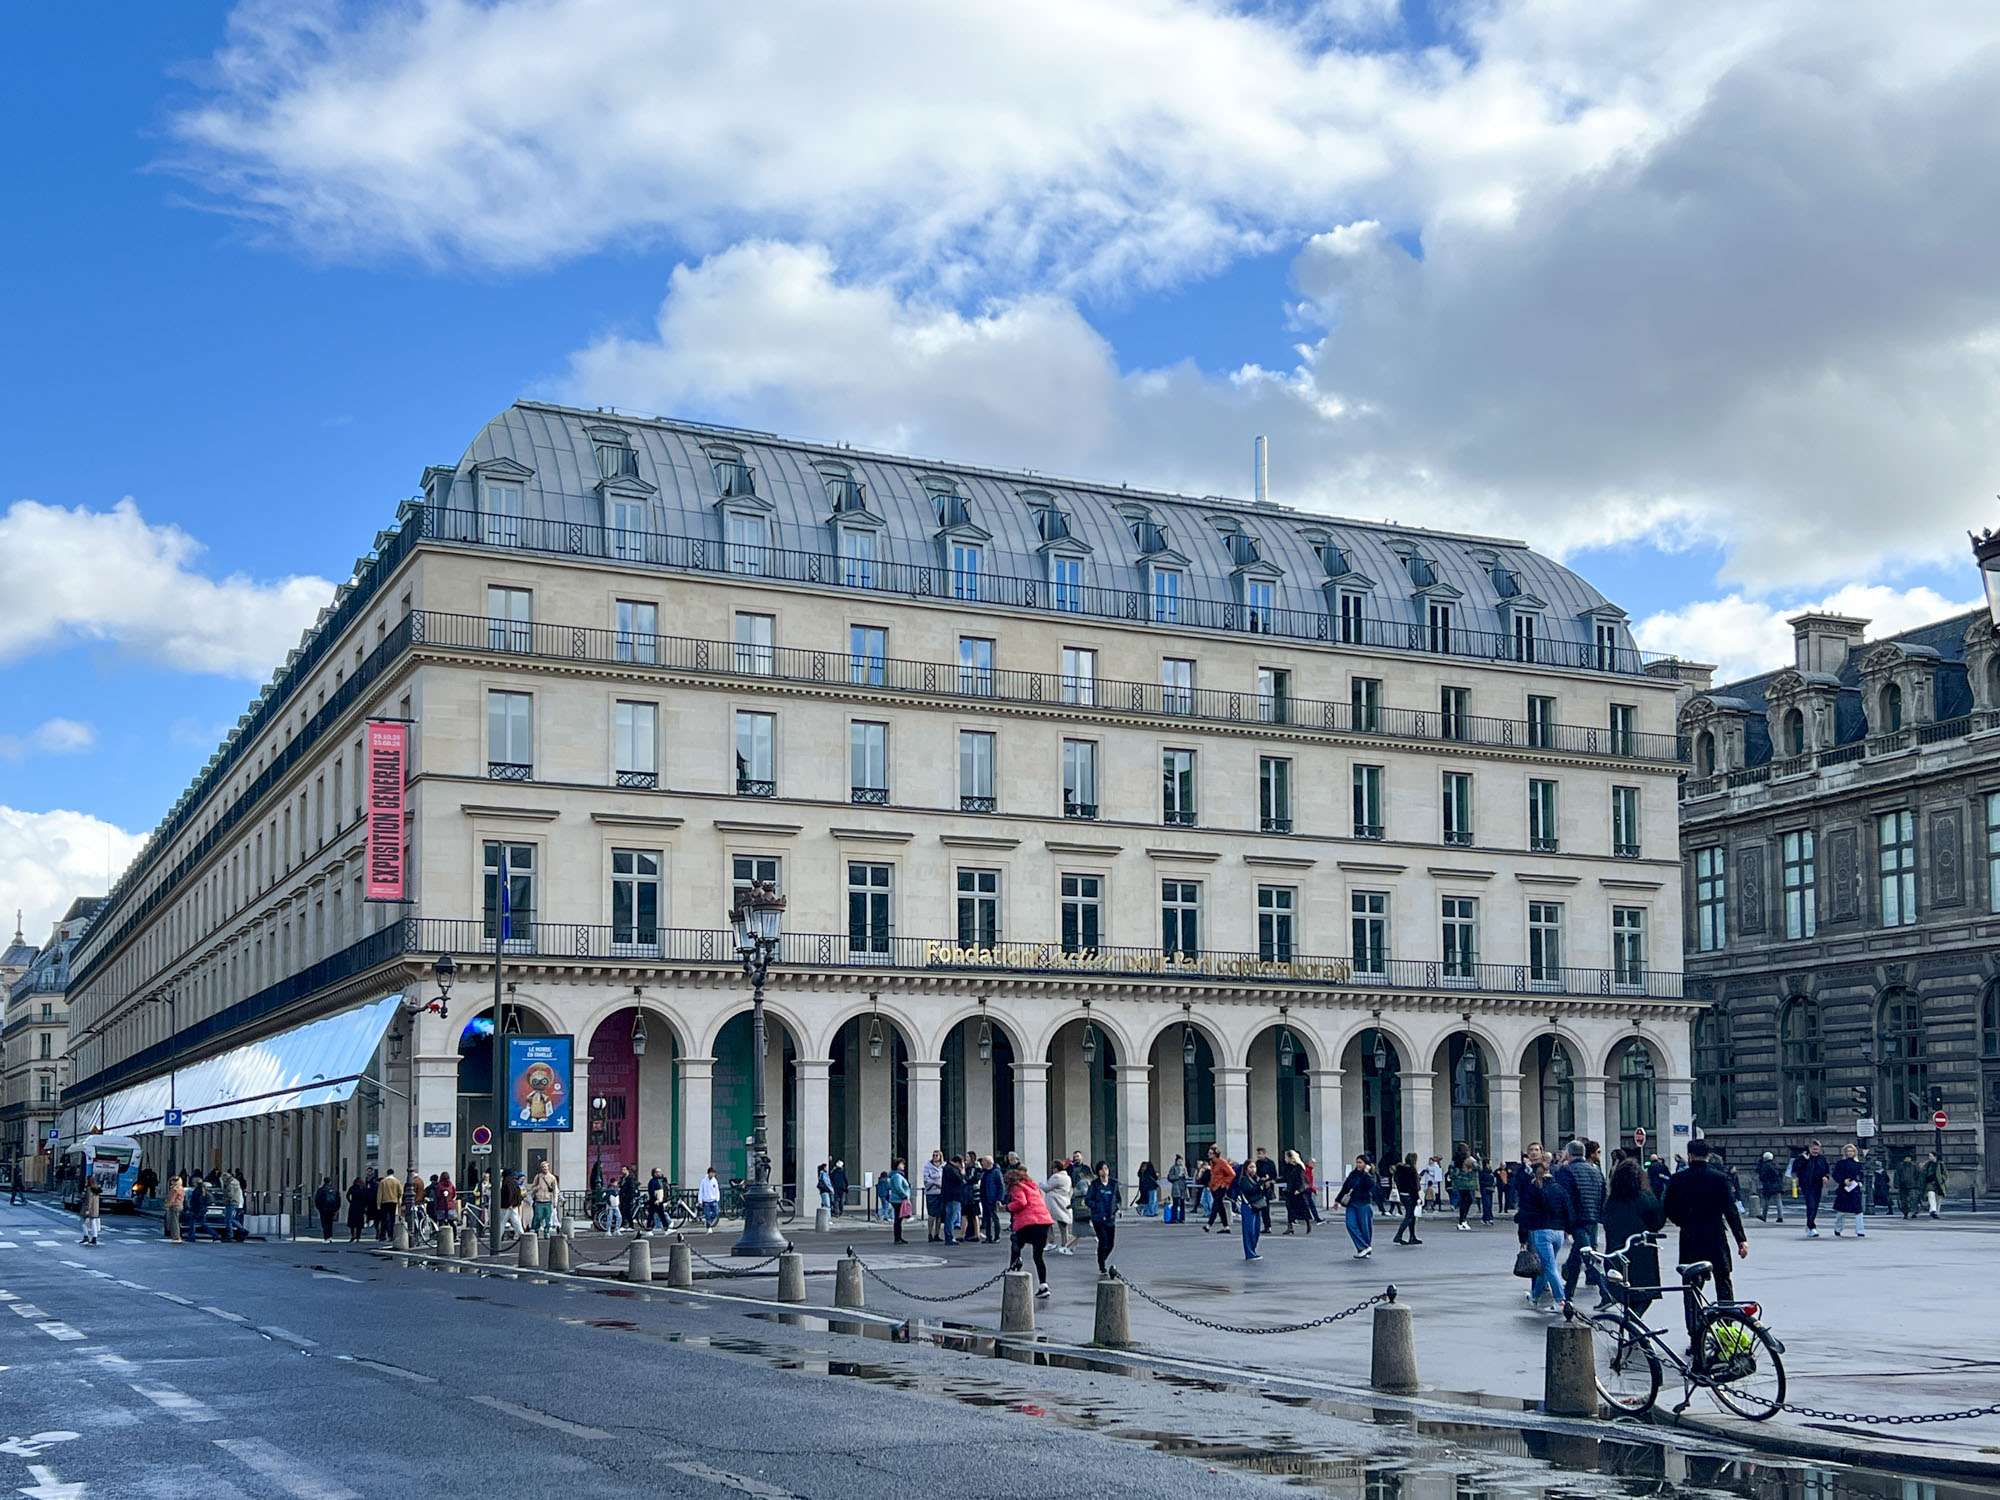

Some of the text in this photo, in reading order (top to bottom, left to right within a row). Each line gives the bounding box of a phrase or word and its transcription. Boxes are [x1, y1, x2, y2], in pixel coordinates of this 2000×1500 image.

[372, 813, 400, 883] EXPOSITION
[926, 940, 1034, 967] Fondation
[1034, 942, 1117, 969] Cartier
[1124, 954, 1170, 973] pour
[169, 1112, 177, 1124] P
